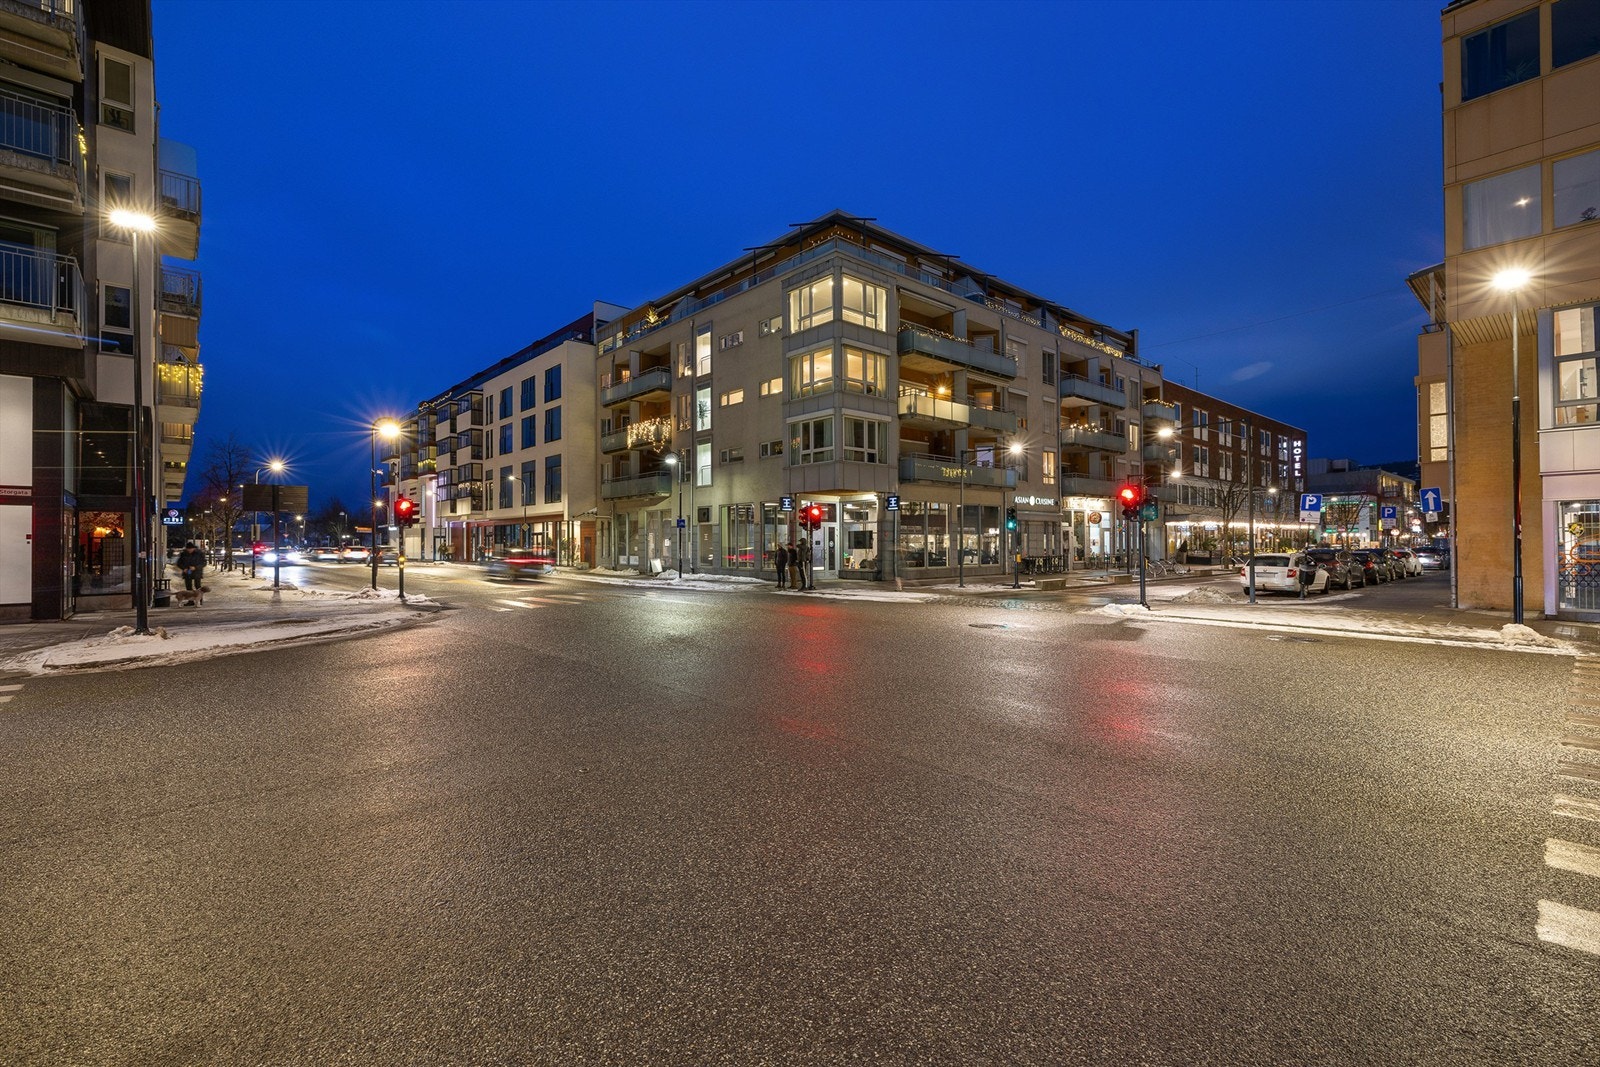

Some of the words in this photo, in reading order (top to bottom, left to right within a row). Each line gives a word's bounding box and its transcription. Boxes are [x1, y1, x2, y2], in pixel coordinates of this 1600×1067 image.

[1293, 440, 1302, 476] HOTEL
[1014, 496, 1030, 504] ASIAN
[1035, 497, 1055, 506] CUISINE
[1305, 496, 1317, 509] P
[1384, 508, 1393, 517] P
